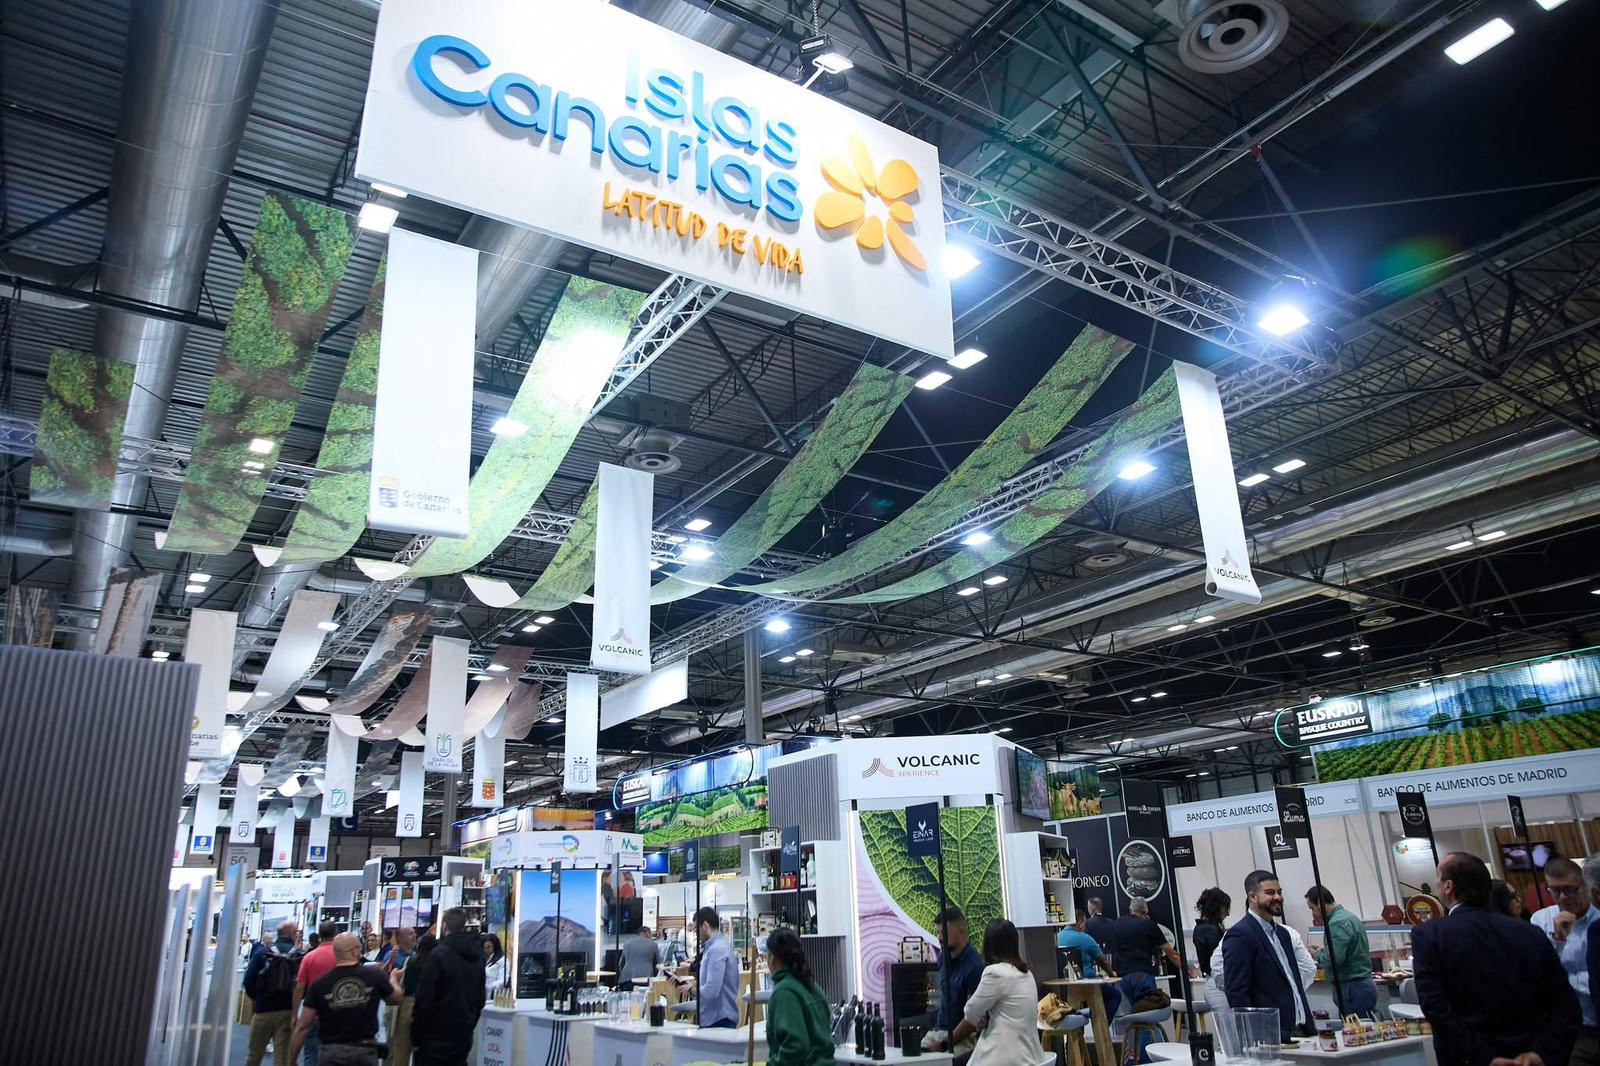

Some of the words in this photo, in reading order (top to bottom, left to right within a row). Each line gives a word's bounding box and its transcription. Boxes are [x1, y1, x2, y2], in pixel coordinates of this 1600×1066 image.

[624, 46, 801, 168] Islas
[411, 33, 803, 224] Canarias
[602, 181, 707, 238] LATITUD
[716, 220, 747, 257] DE
[753, 234, 804, 275] VIDA
[403, 489, 450, 503] Gobierno
[1214, 567, 1251, 583] VOLCANIC
[598, 644, 643, 656] VOLCANIC
[1297, 700, 1364, 725] EUSKADI
[1299, 723, 1328, 735] BASQUE
[1328, 716, 1366, 730] COUNTRY
[897, 754, 981, 768] VOLCANIC
[898, 769, 940, 777] XPERIENCE
[1378, 784, 1416, 798] BANCO
[1418, 782, 1433, 793] DE
[1435, 775, 1496, 792] ALIMENTOS
[1499, 773, 1514, 784] DE
[1517, 767, 1568, 782] MADRID
[1186, 809, 1216, 822] BANCO
[1216, 807, 1228, 818] DE
[1229, 803, 1274, 816] ALIMENTOS
